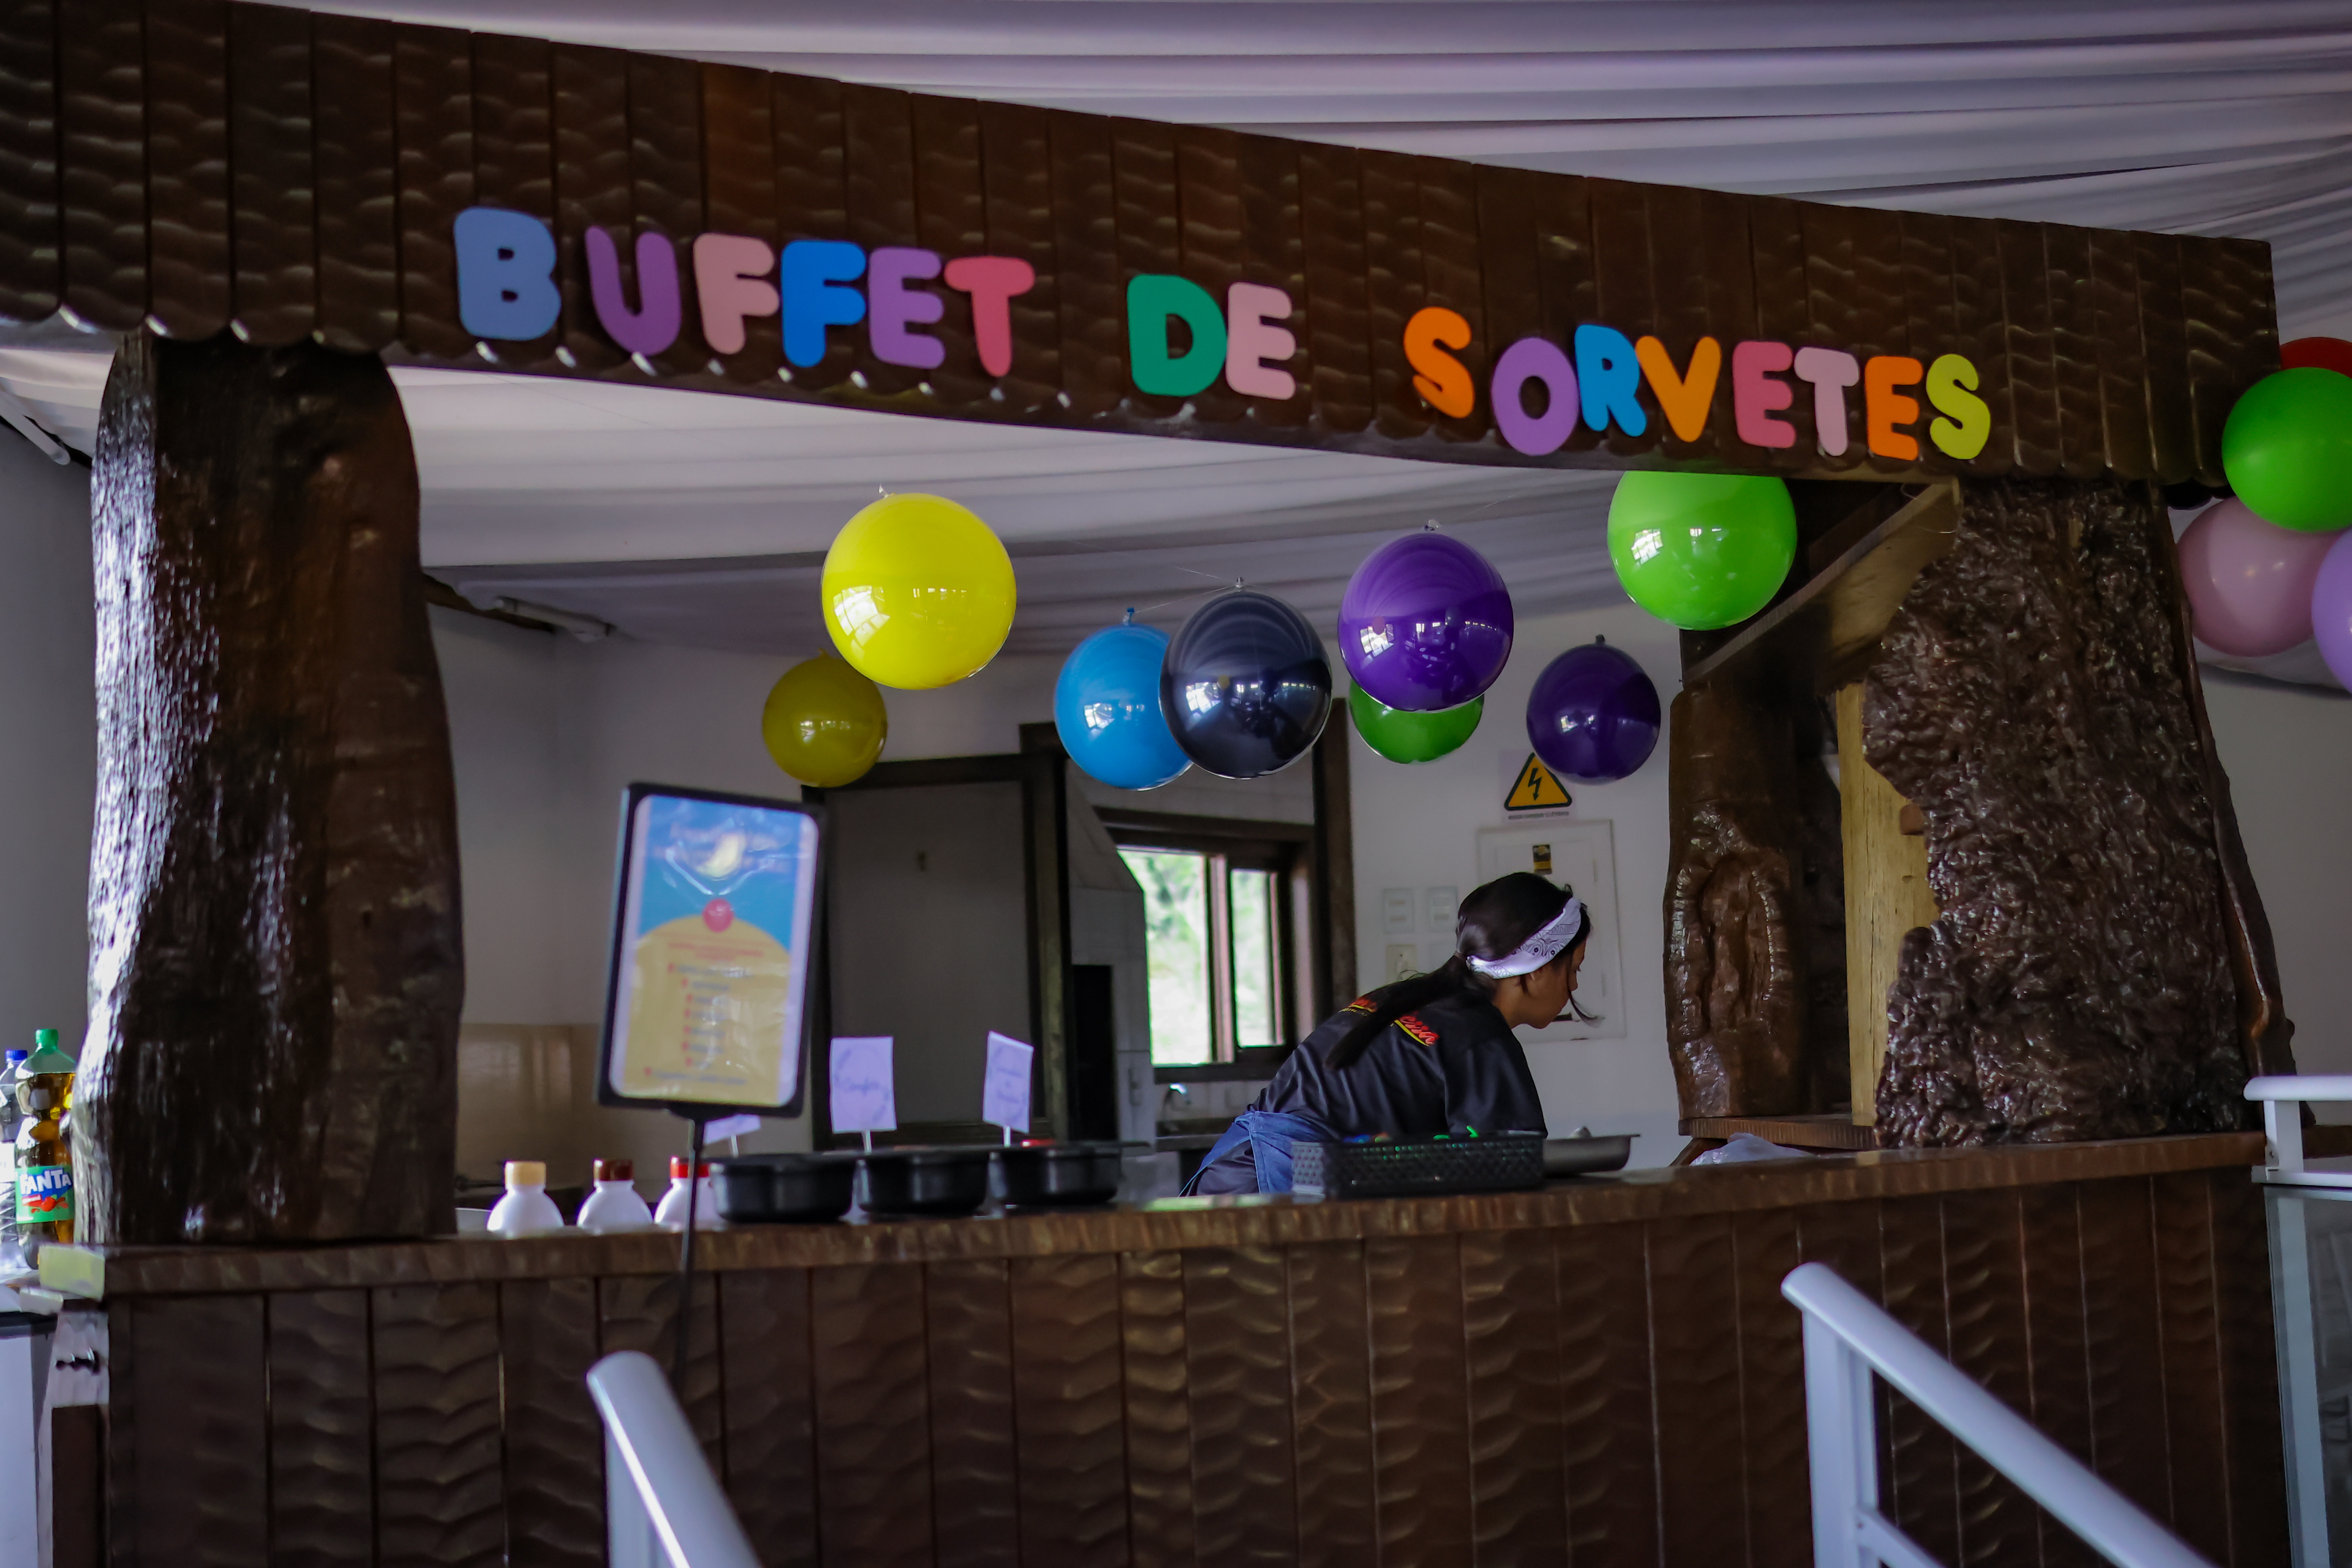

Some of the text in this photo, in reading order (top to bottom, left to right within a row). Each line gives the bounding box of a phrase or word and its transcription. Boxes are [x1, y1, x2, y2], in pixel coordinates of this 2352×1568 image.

[453, 206, 1991, 462] BUFFET DE SORVETES
[19, 1169, 72, 1195] FANTA
